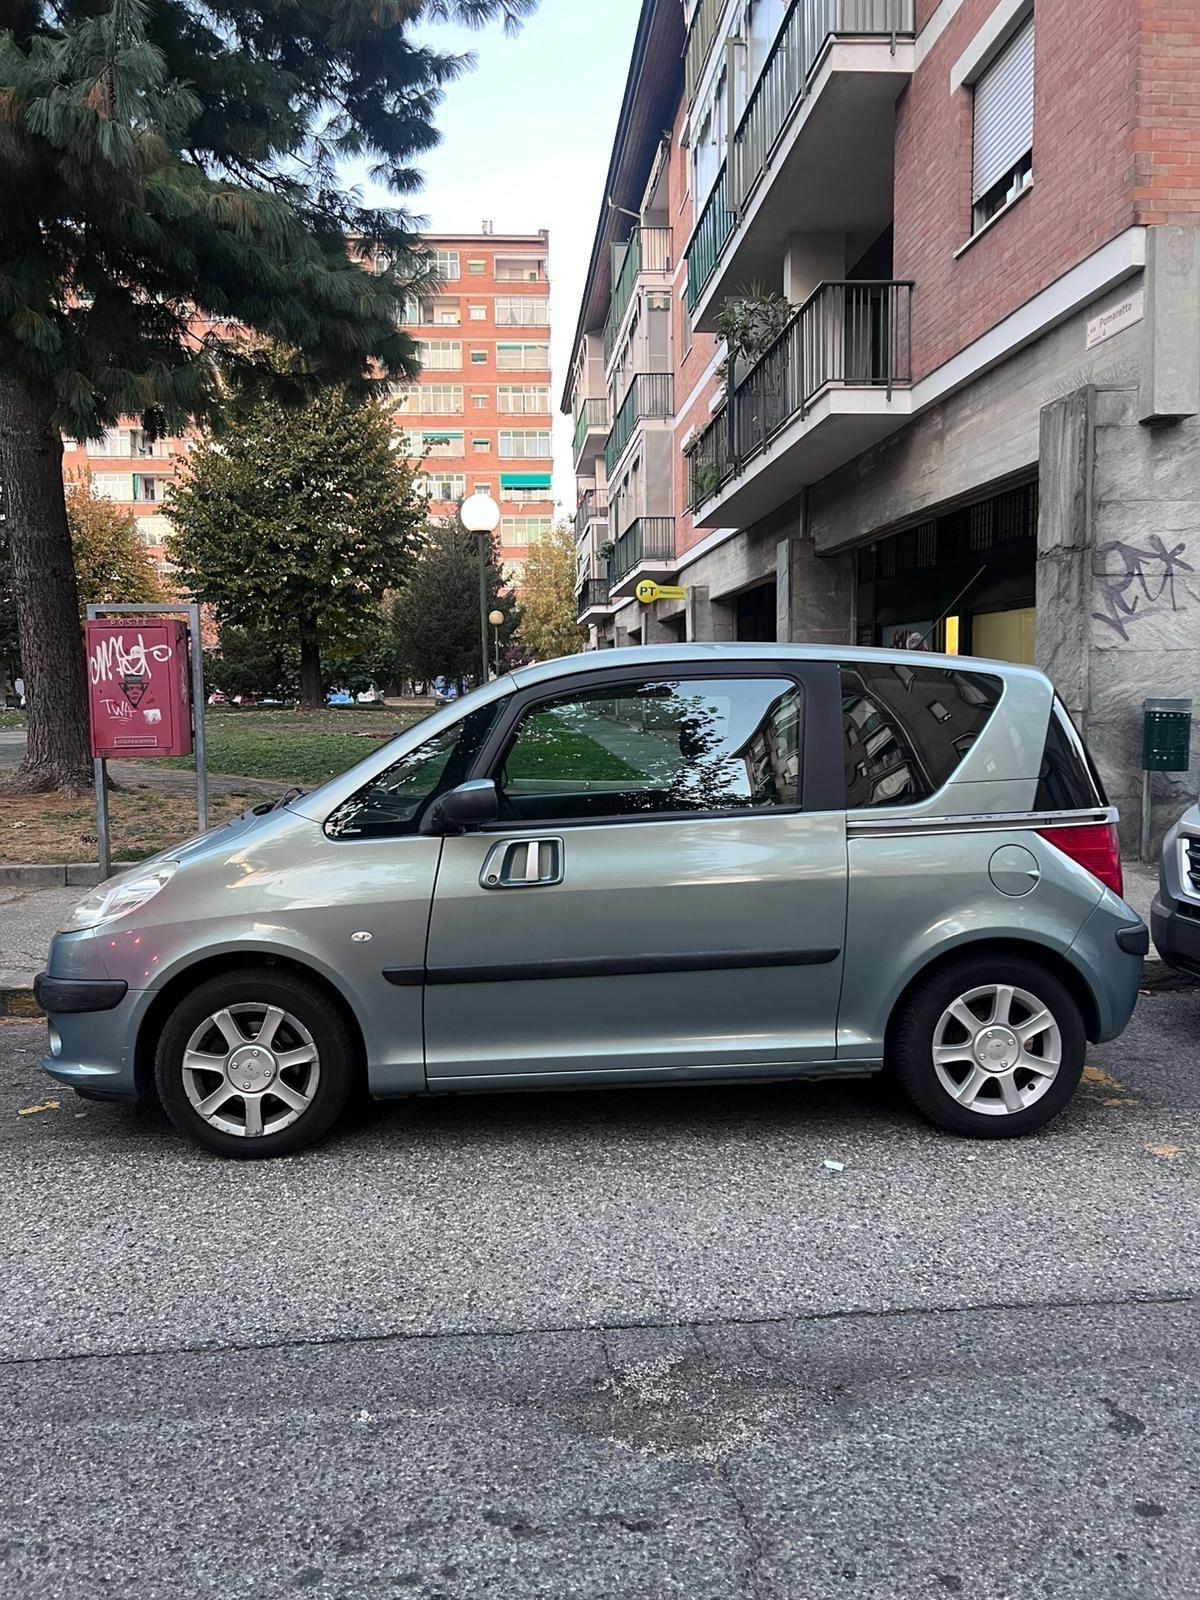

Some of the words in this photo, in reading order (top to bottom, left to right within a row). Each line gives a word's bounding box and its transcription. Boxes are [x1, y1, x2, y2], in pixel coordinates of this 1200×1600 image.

[1099, 303, 1132, 328] Pomaretto
[640, 586, 656, 596] PT
[110, 619, 149, 627] POSTE
